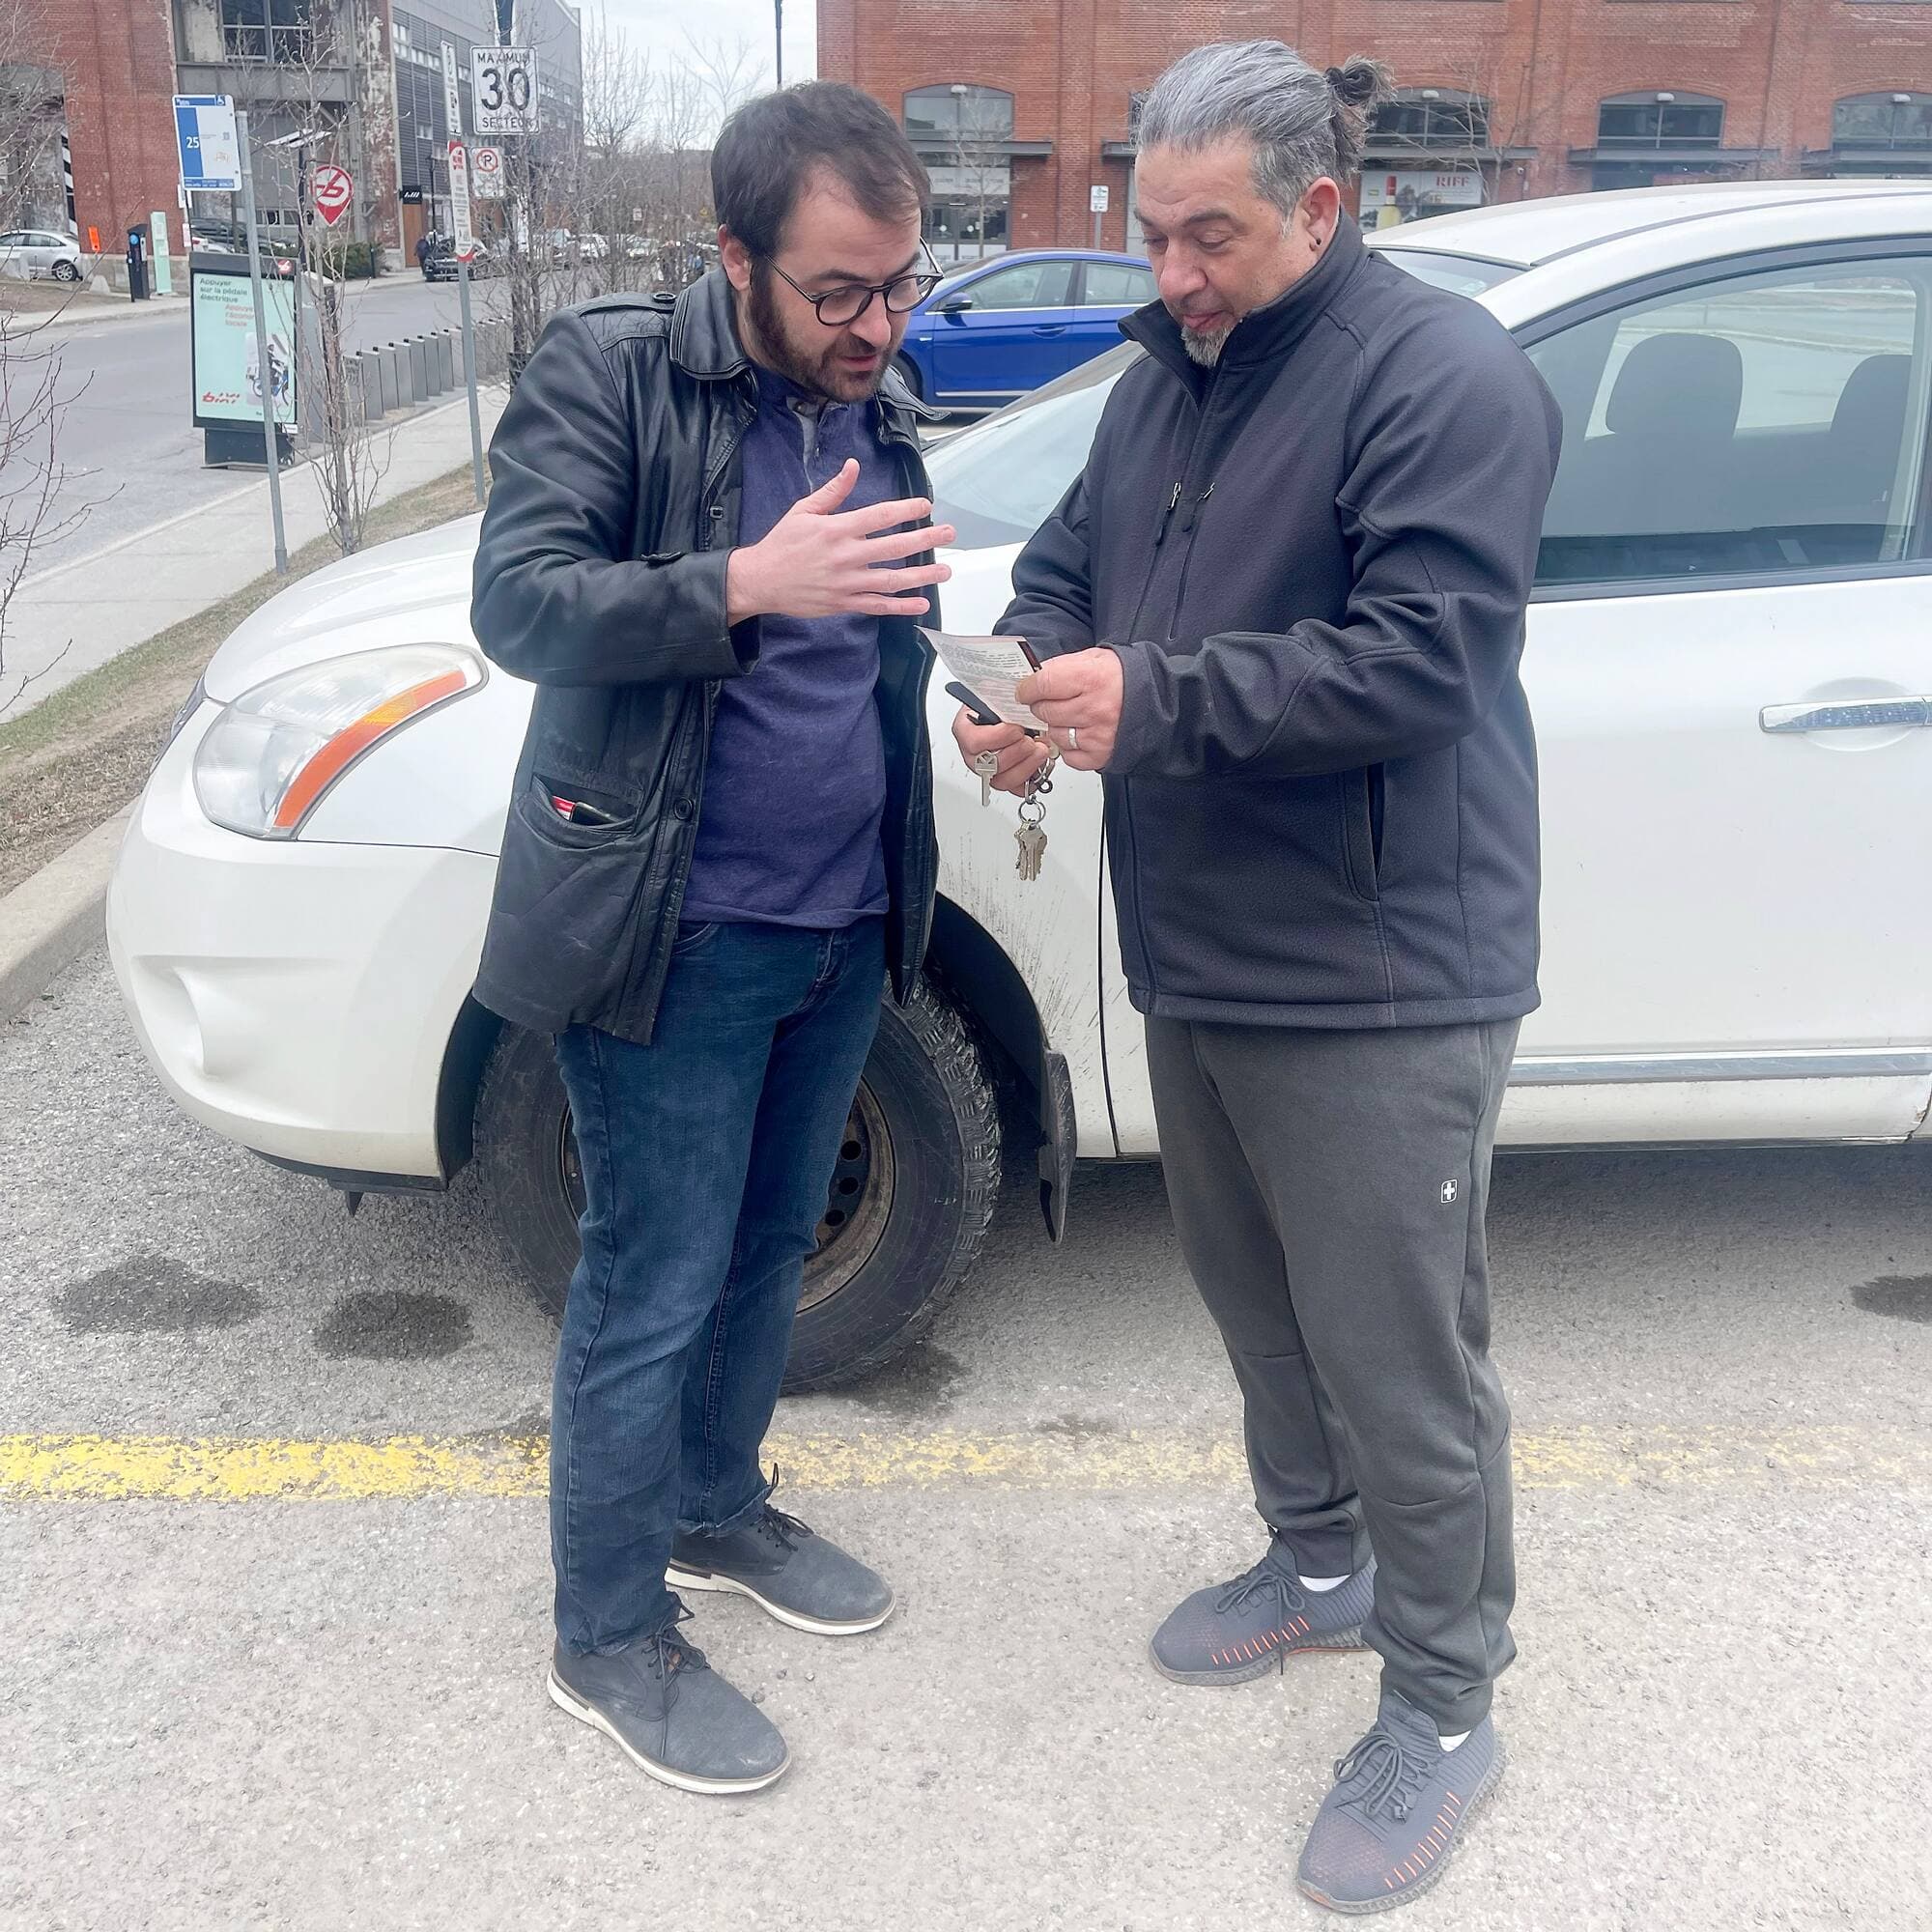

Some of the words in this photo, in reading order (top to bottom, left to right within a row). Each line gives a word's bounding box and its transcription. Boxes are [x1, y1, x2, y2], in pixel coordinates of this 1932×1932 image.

[481, 68, 530, 111] 30
[185, 136, 200, 149] 25
[1436, 176, 1470, 187] RIFF
[200, 278, 232, 287] Appuyer
